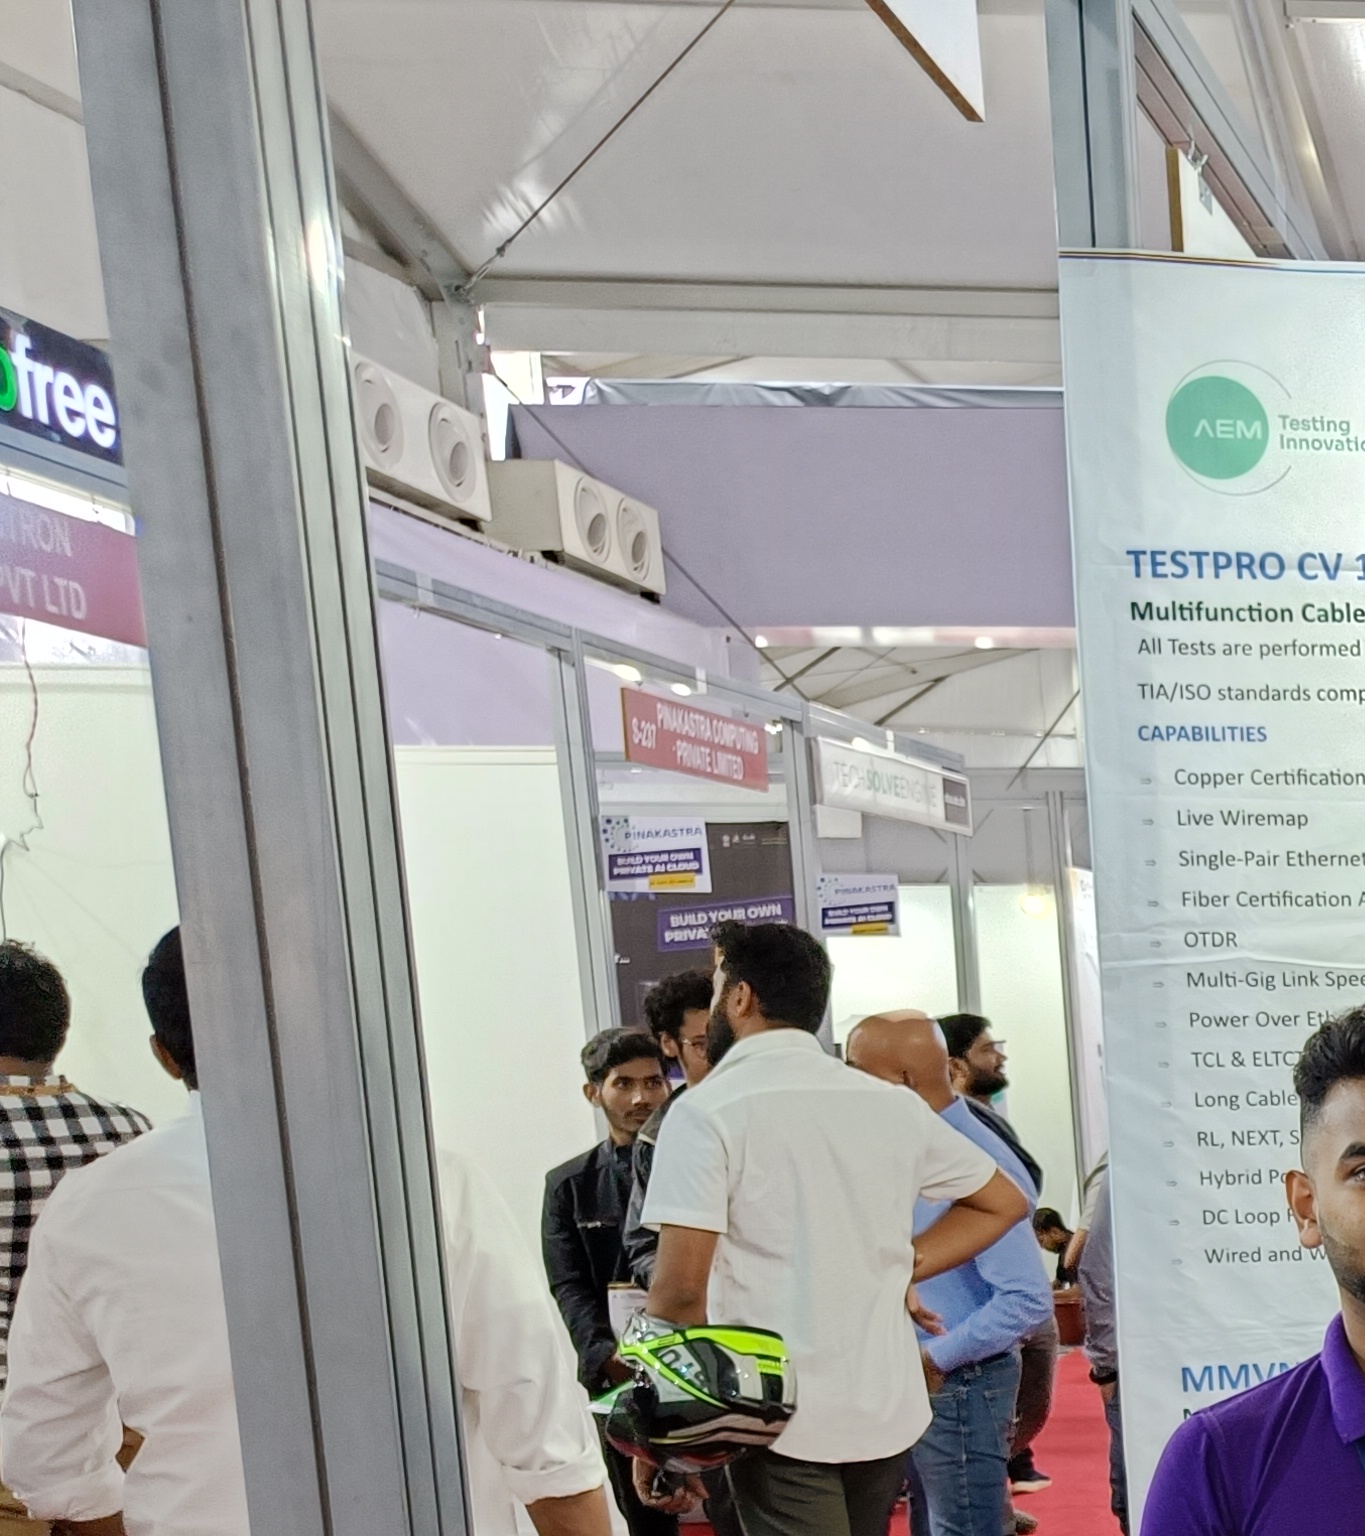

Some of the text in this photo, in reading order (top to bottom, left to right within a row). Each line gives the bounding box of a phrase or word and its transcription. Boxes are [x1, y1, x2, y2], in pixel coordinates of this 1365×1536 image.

[1194, 418, 1263, 440] AEM
[1278, 415, 1351, 436] Testing
[1125, 549, 1287, 581] TESTPRO
[1297, 551, 1344, 581] CV
[42, 575, 87, 620] LTD
[1129, 600, 1294, 623] Multifunction
[1137, 637, 1162, 655] All
[1167, 638, 1217, 656] Tests
[1222, 643, 1253, 657] are
[1259, 638, 1362, 660] performed
[1137, 682, 1212, 703] TIA/ISO
[1217, 684, 1312, 702] standards
[1137, 724, 1268, 743] CAPABILITIES
[1173, 768, 1244, 789] Copper
[1176, 809, 1309, 831] Live Wiremap
[625, 827, 703, 841] PINAKASTRA
[1178, 849, 1280, 872] Single-Pair
[1181, 890, 1231, 908] Fiber
[1235, 889, 1353, 908] Certification
[670, 902, 782, 928] BUILD YOUR OWN
[1183, 930, 1239, 949] OTDR
[1185, 970, 1277, 992] Multi-Gig
[1281, 969, 1320, 988] Link
